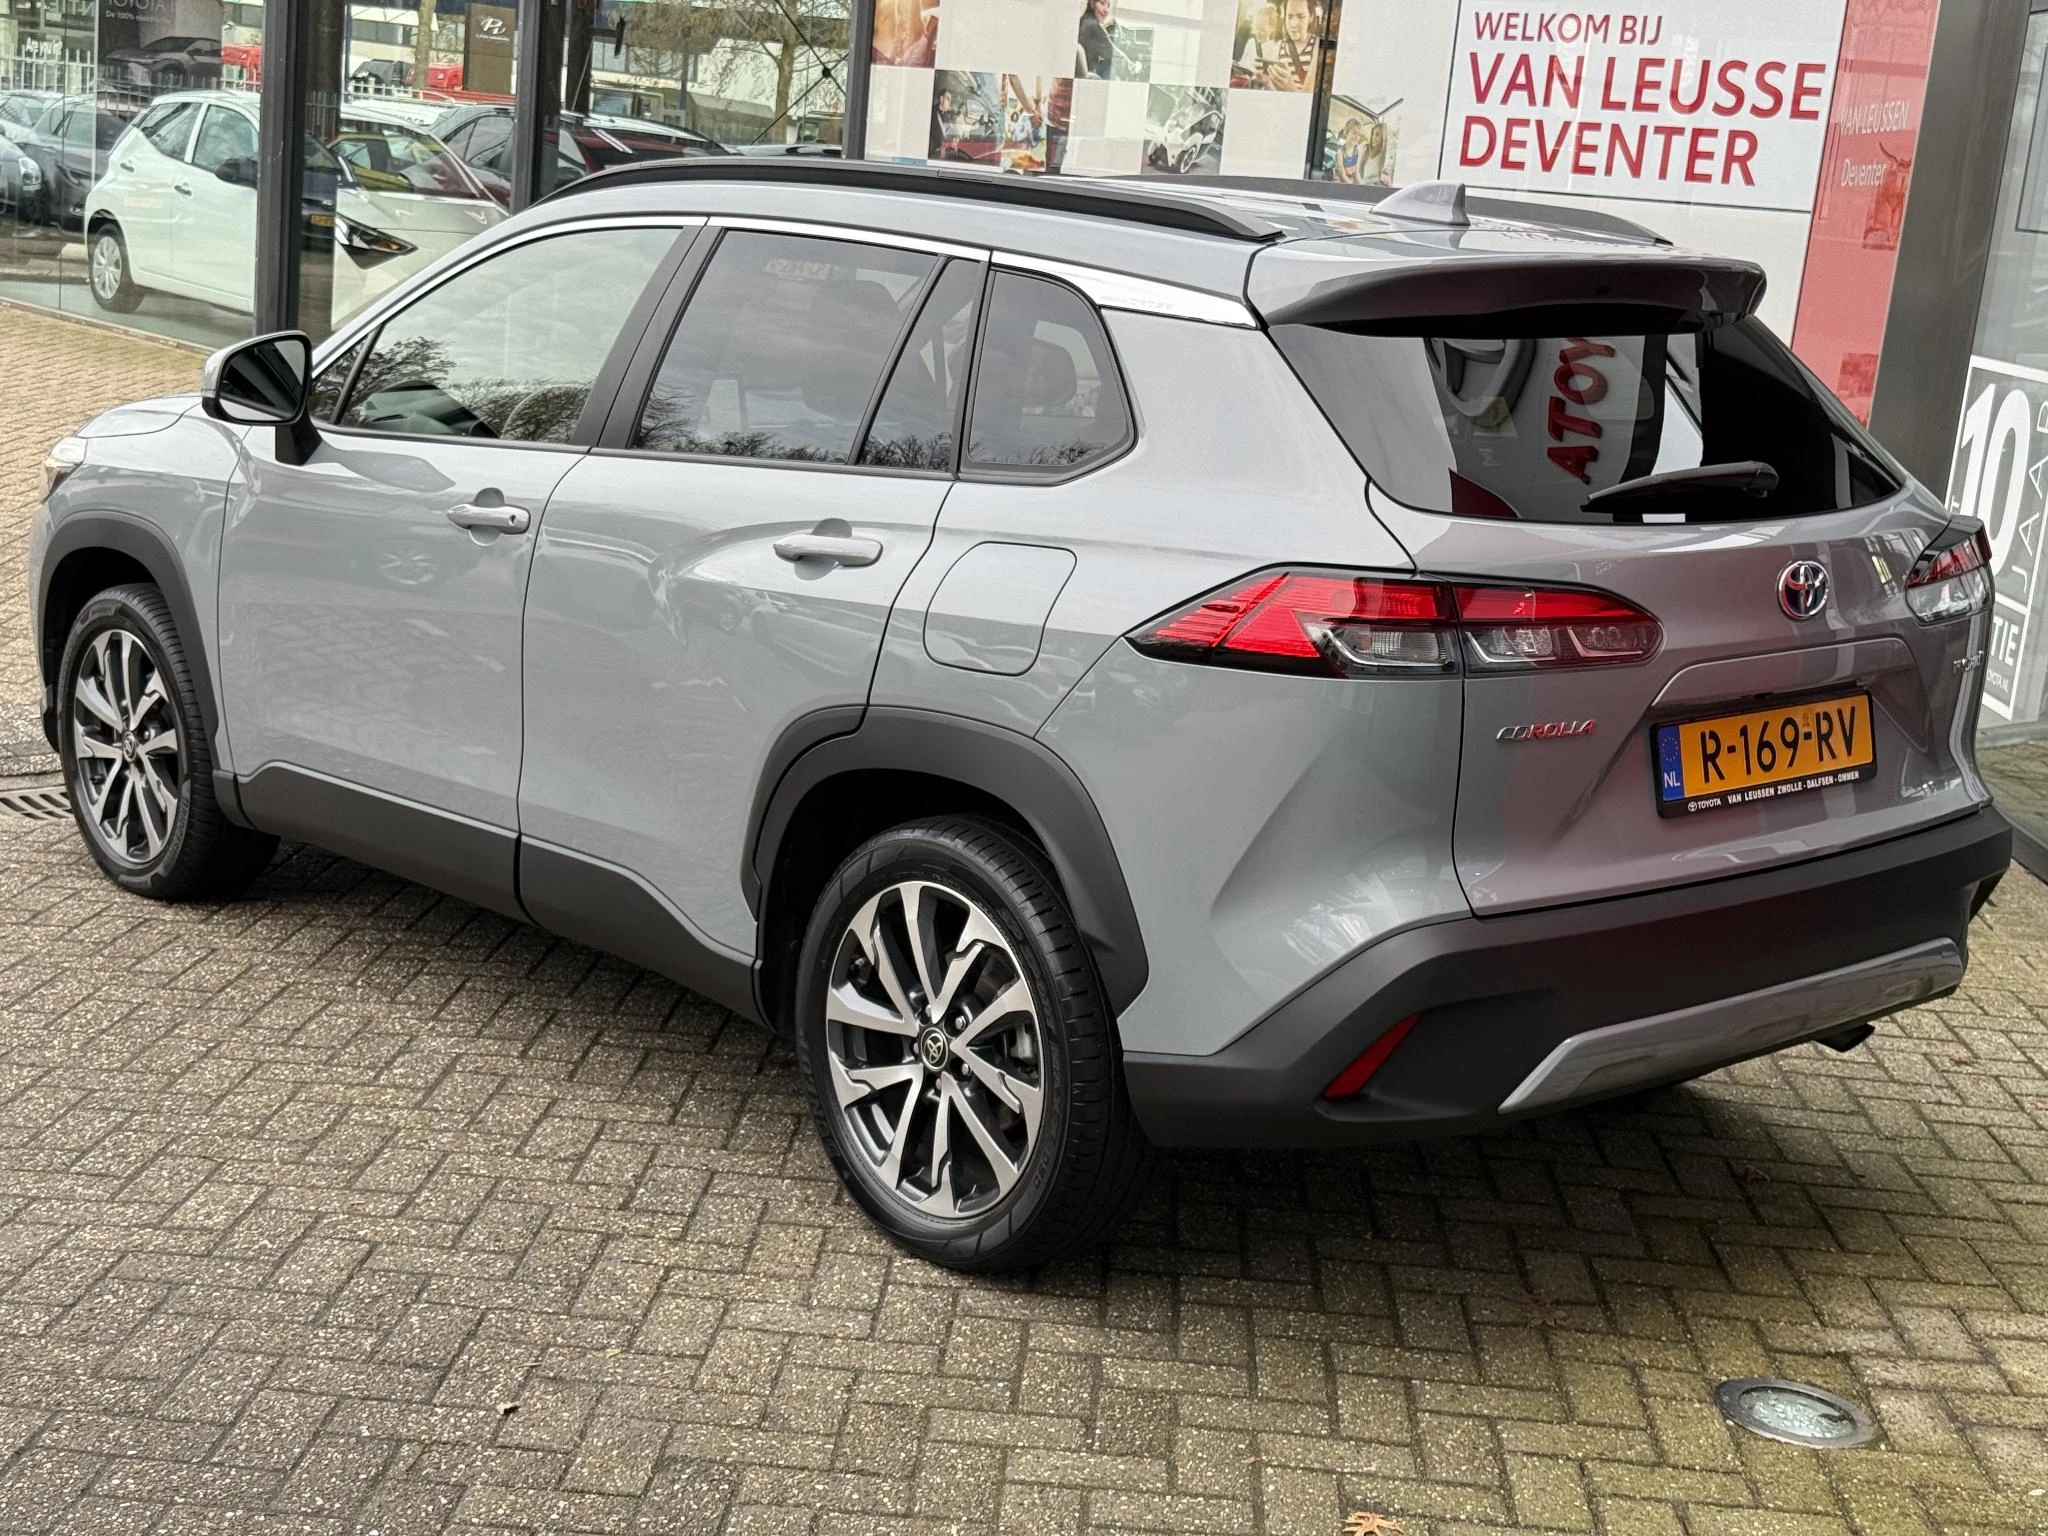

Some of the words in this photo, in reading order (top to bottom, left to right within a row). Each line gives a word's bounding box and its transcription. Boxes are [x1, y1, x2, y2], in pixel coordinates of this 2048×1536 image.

[1474, 12, 1611, 44] WELKOM
[1618, 15, 1663, 46] BIJ
[1469, 52, 1585, 110] VAN
[1600, 56, 1826, 121] LEUSSE
[1862, 100, 1909, 135] LEUSSEN
[1459, 115, 1758, 187] DEVENTER
[1840, 158, 1887, 187] Deventer
[1960, 383, 2031, 577] 10
[1495, 719, 1597, 742] COROLLA
[1700, 706, 1856, 784] R-169-RV
[1663, 772, 1681, 788] NL
[1698, 799, 1722, 810] TOYOTA
[1727, 793, 1742, 804] VAN
[1744, 787, 1775, 801] LEUSSEN
[1777, 782, 1803, 795] ZWOLLE
[1806, 776, 1834, 789] DALFSEN
